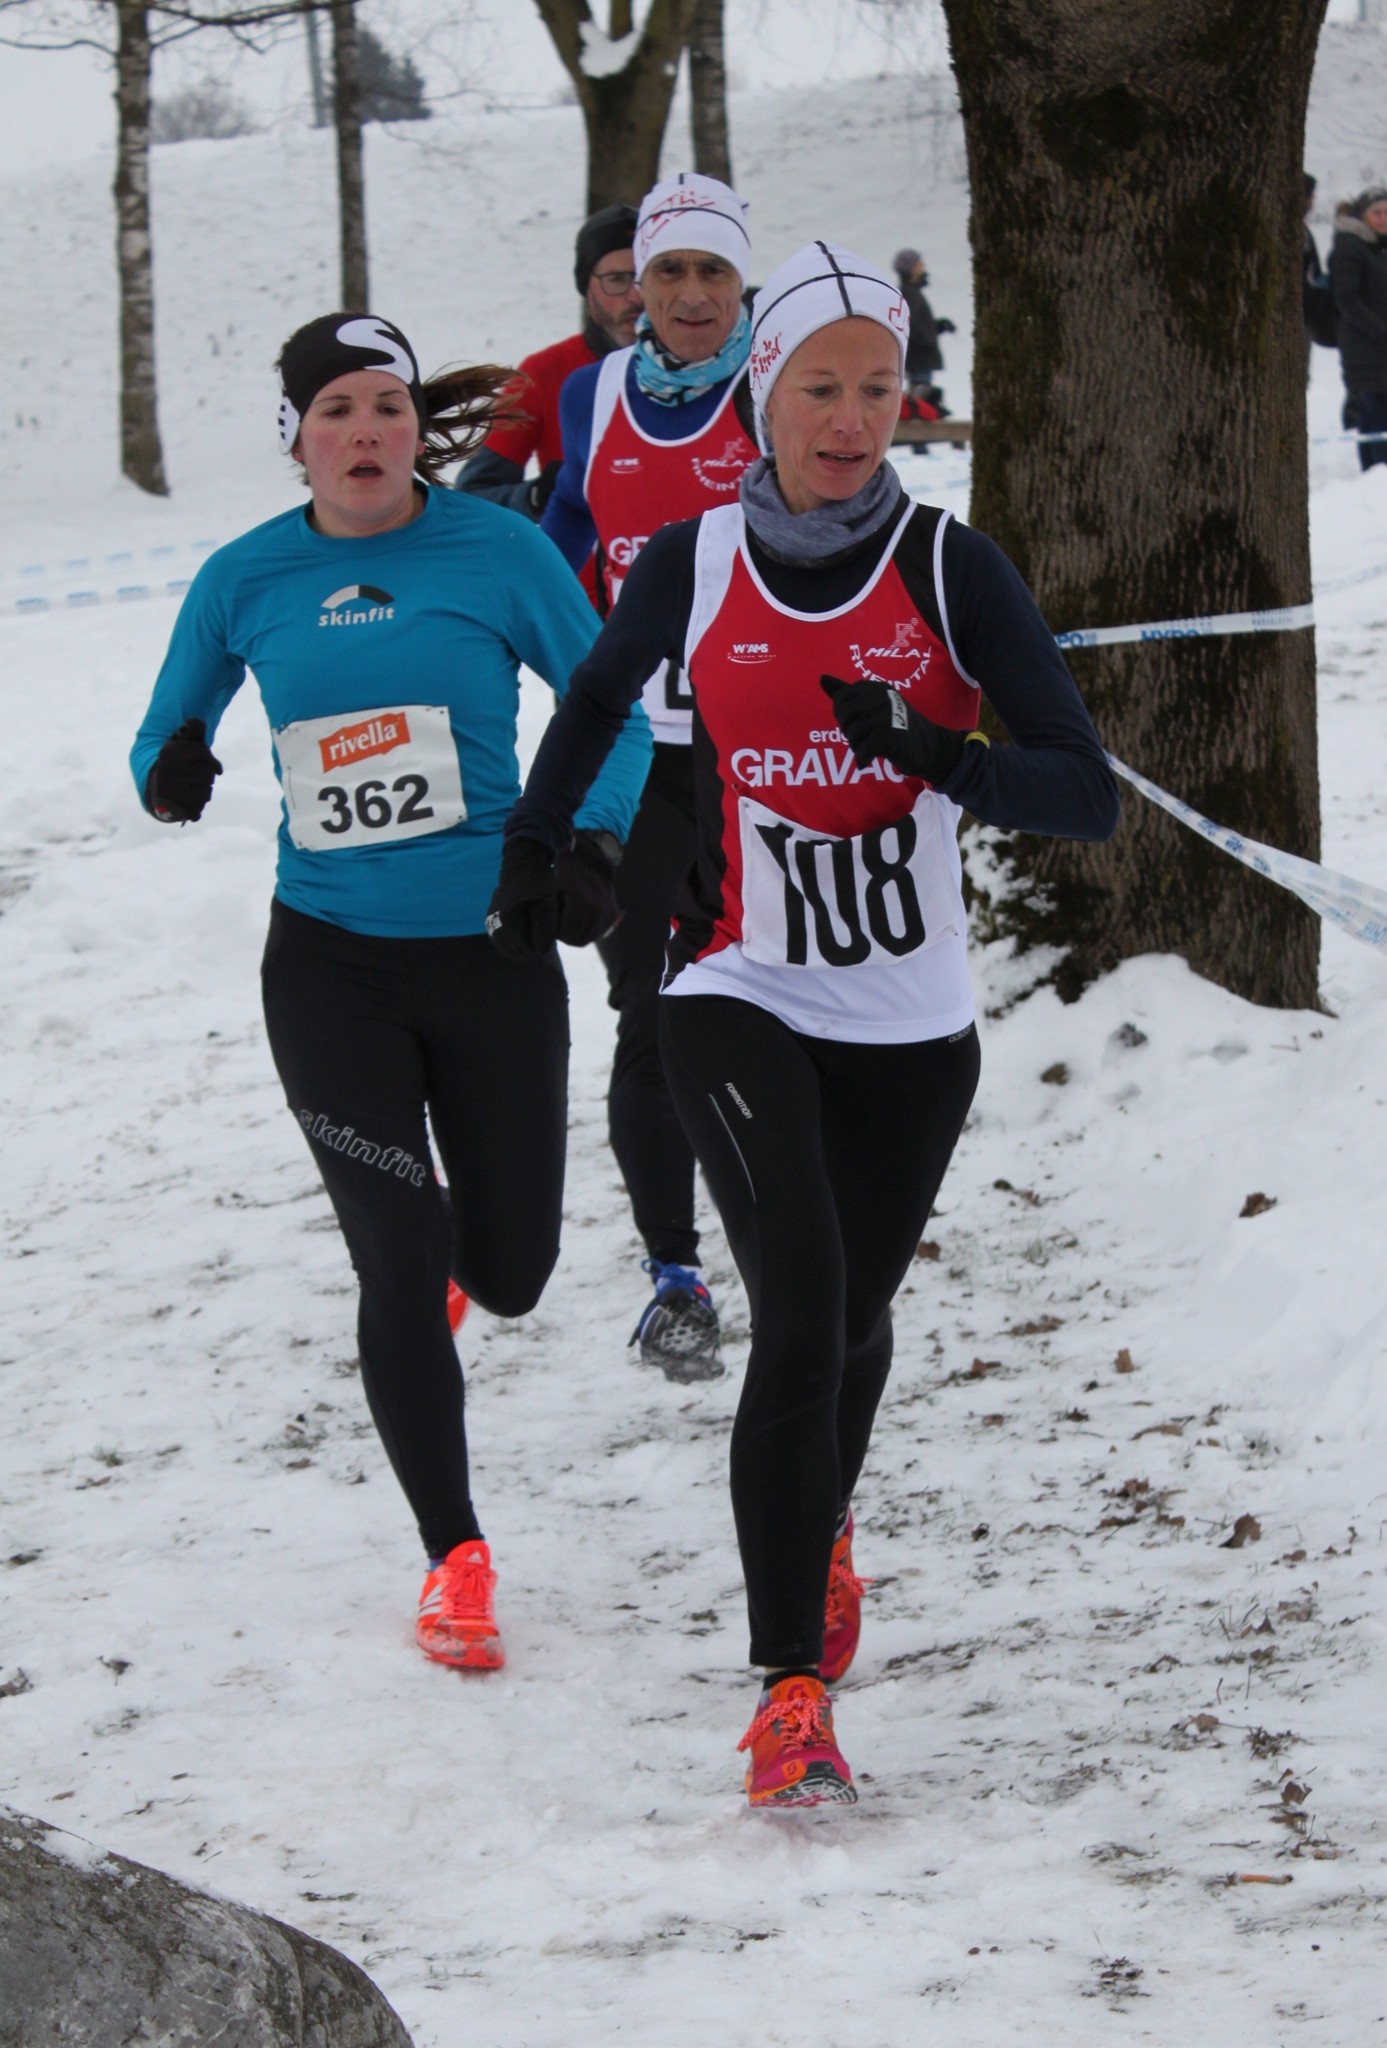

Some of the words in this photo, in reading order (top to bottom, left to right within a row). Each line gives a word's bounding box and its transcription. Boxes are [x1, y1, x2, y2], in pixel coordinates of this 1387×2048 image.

[318, 606, 395, 627] skinfit
[864, 647, 921, 658] MILA
[328, 719, 398, 761] rivella
[317, 773, 435, 834] 362
[753, 812, 926, 967] 108
[298, 1108, 426, 1187] skinfit
